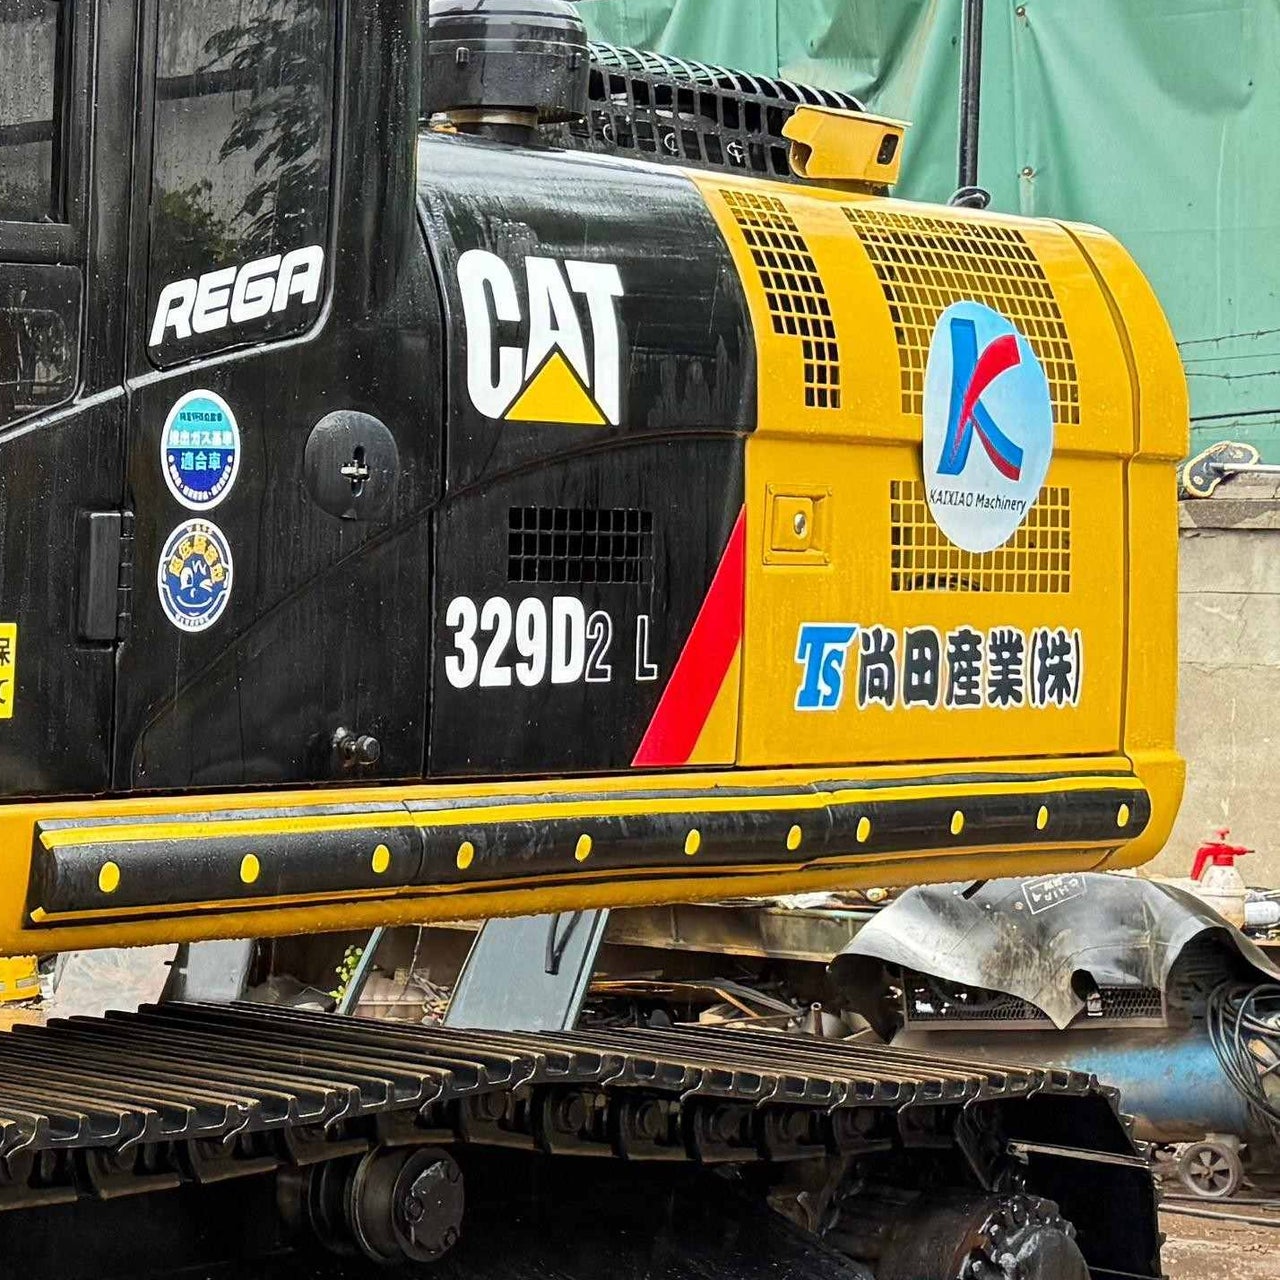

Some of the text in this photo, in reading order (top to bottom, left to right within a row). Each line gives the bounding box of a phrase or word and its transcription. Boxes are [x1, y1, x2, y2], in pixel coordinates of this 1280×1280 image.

[148, 245, 325, 347] REGA
[456, 249, 625, 426] CAT
[930, 488, 1027, 515] KAIXIAO Machinery
[635, 614, 658, 681] L
